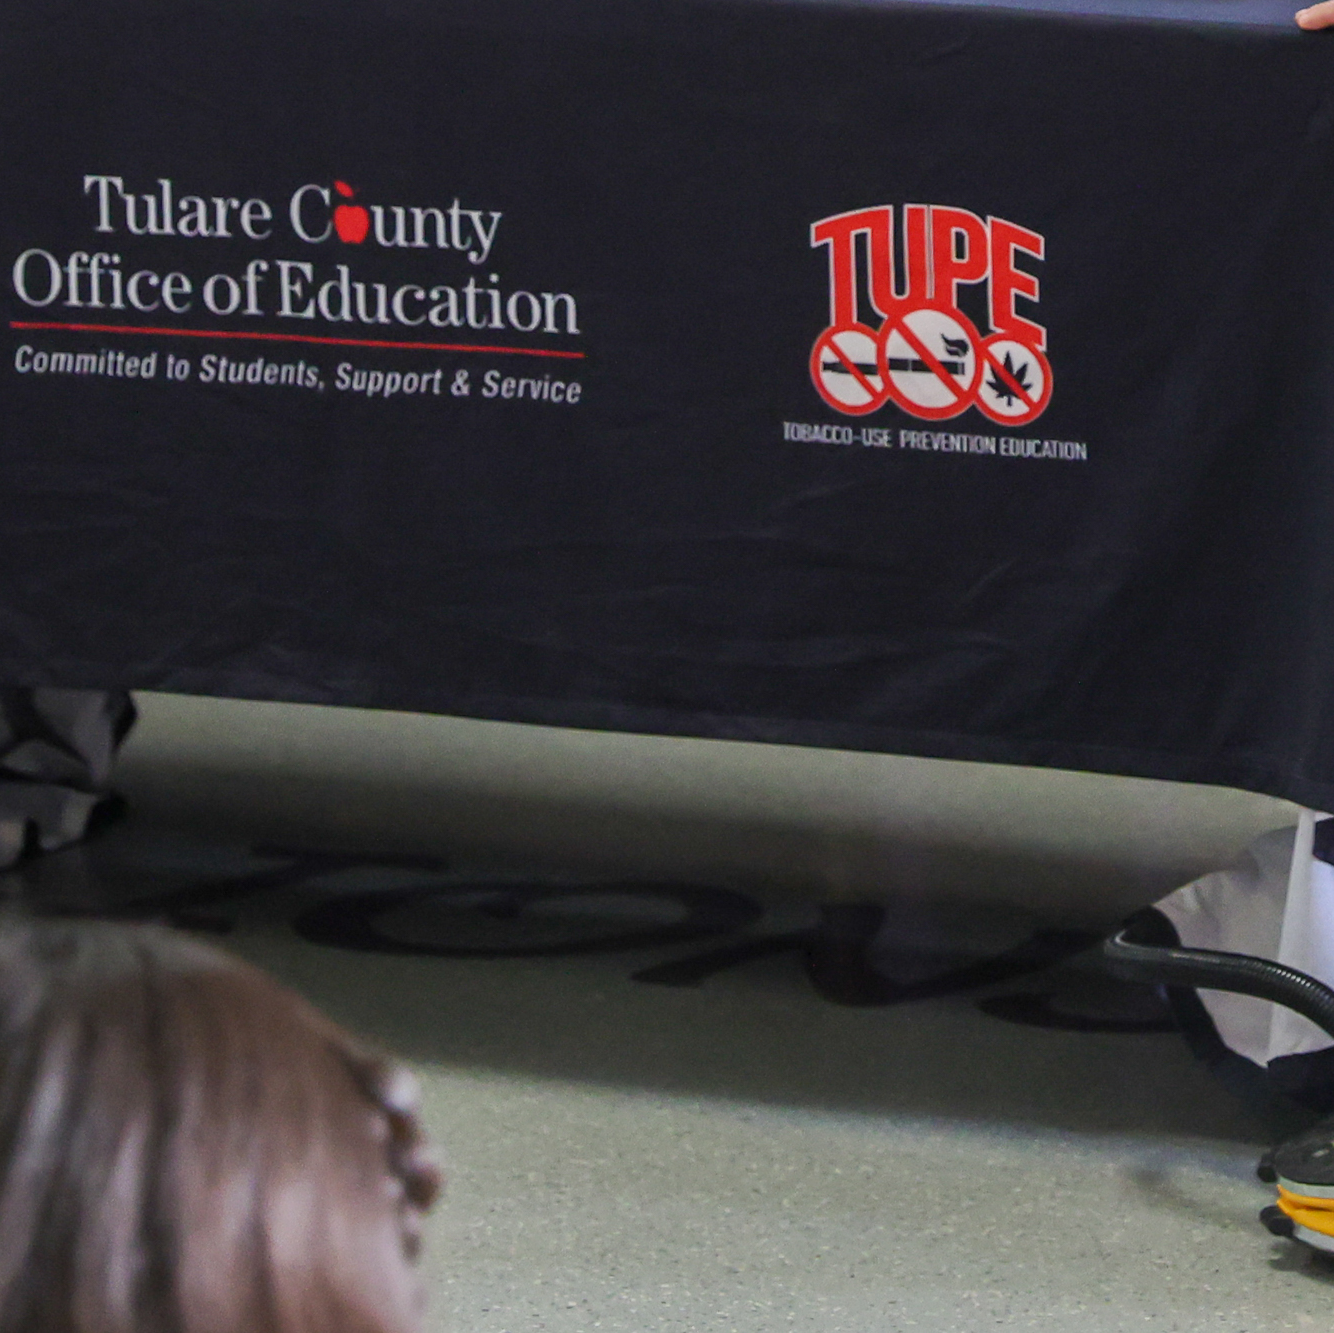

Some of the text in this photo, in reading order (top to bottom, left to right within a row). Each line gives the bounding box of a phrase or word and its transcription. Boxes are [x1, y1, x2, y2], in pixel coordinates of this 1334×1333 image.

[84, 175, 273, 239] Tulare
[12, 248, 581, 335] Office of Education
[810, 203, 1047, 353] TUPE
[14, 345, 582, 405] Committed to Students, Support & Service
[783, 421, 1088, 461] TOBACCO-USE PREVENTION EDUCATION
